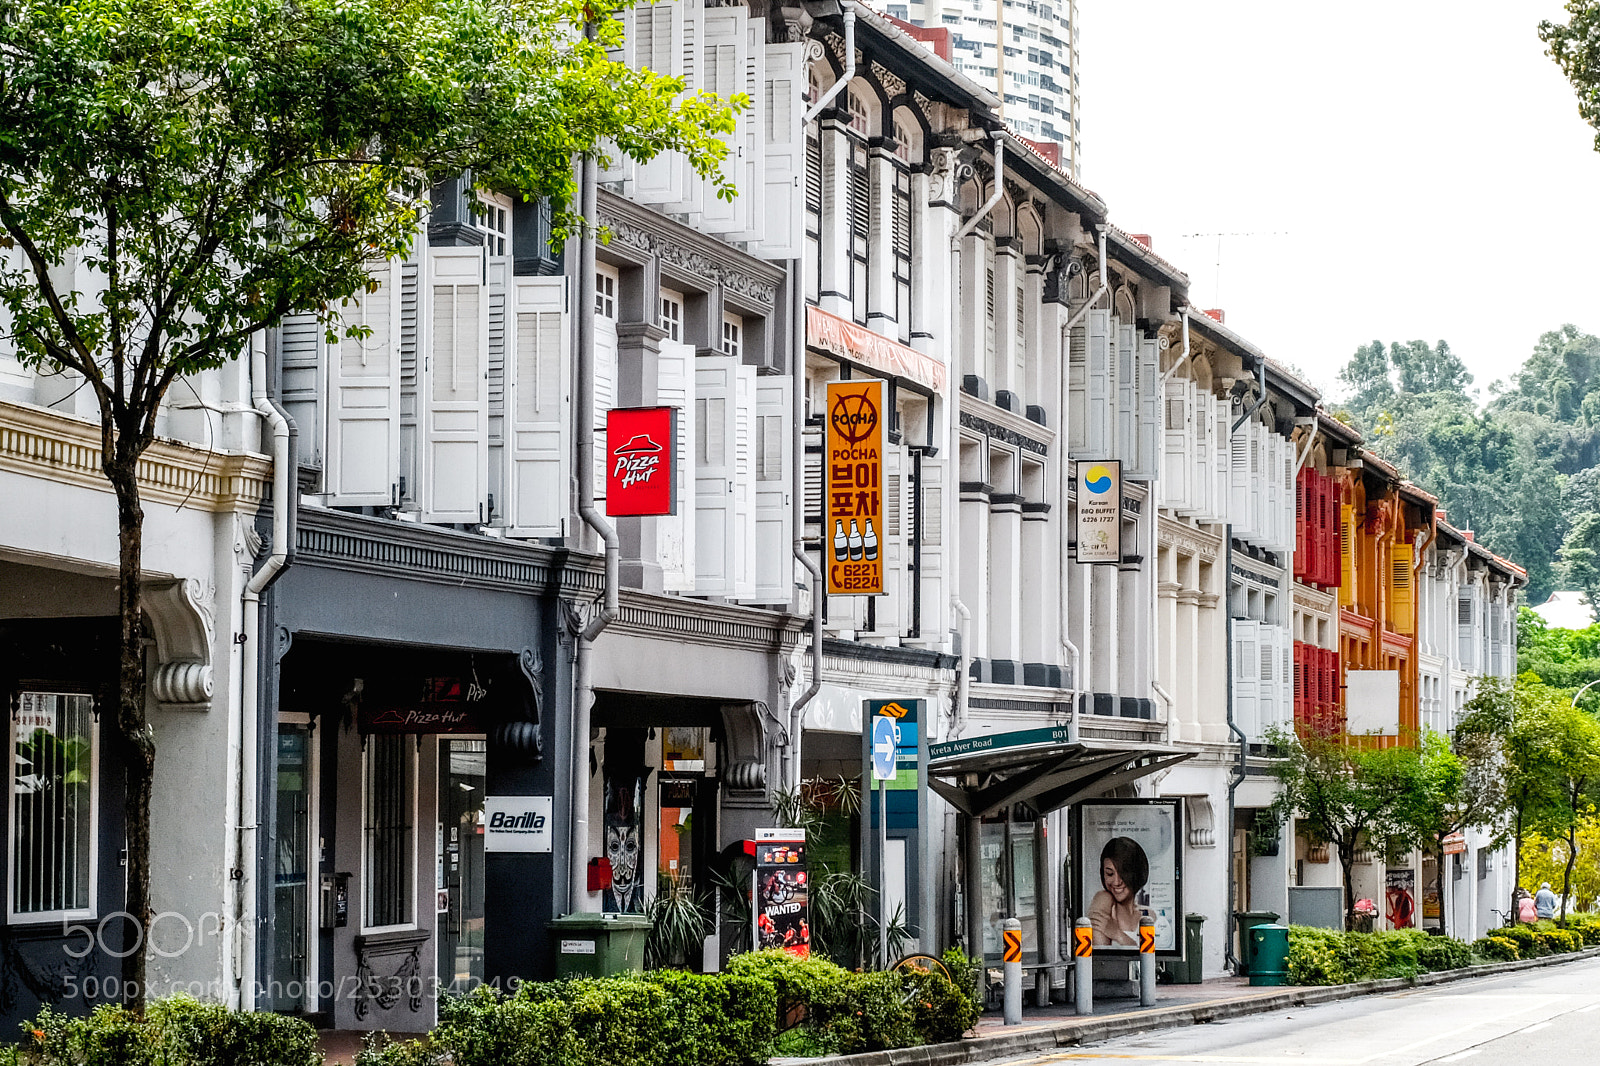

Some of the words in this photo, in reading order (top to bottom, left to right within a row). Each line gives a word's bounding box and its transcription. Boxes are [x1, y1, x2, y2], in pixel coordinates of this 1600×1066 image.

[832, 413, 876, 425] POCHA
[832, 449, 878, 460] POCHA
[613, 453, 660, 478] Pizza
[621, 466, 658, 489] Hut
[832, 463, 878, 488] 브이
[832, 491, 880, 516] 포차
[844, 564, 878, 577] 6221
[844, 577, 880, 589] 6224
[404, 710, 440, 725] Pizza
[441, 710, 468, 723] Hut
[1052, 729, 1067, 739] B01
[930, 744, 952, 757] Kreta
[953, 743, 971, 753] Ayer
[972, 738, 993, 748] Road
[489, 812, 546, 828] Barilla
[765, 903, 801, 916] WANTED
